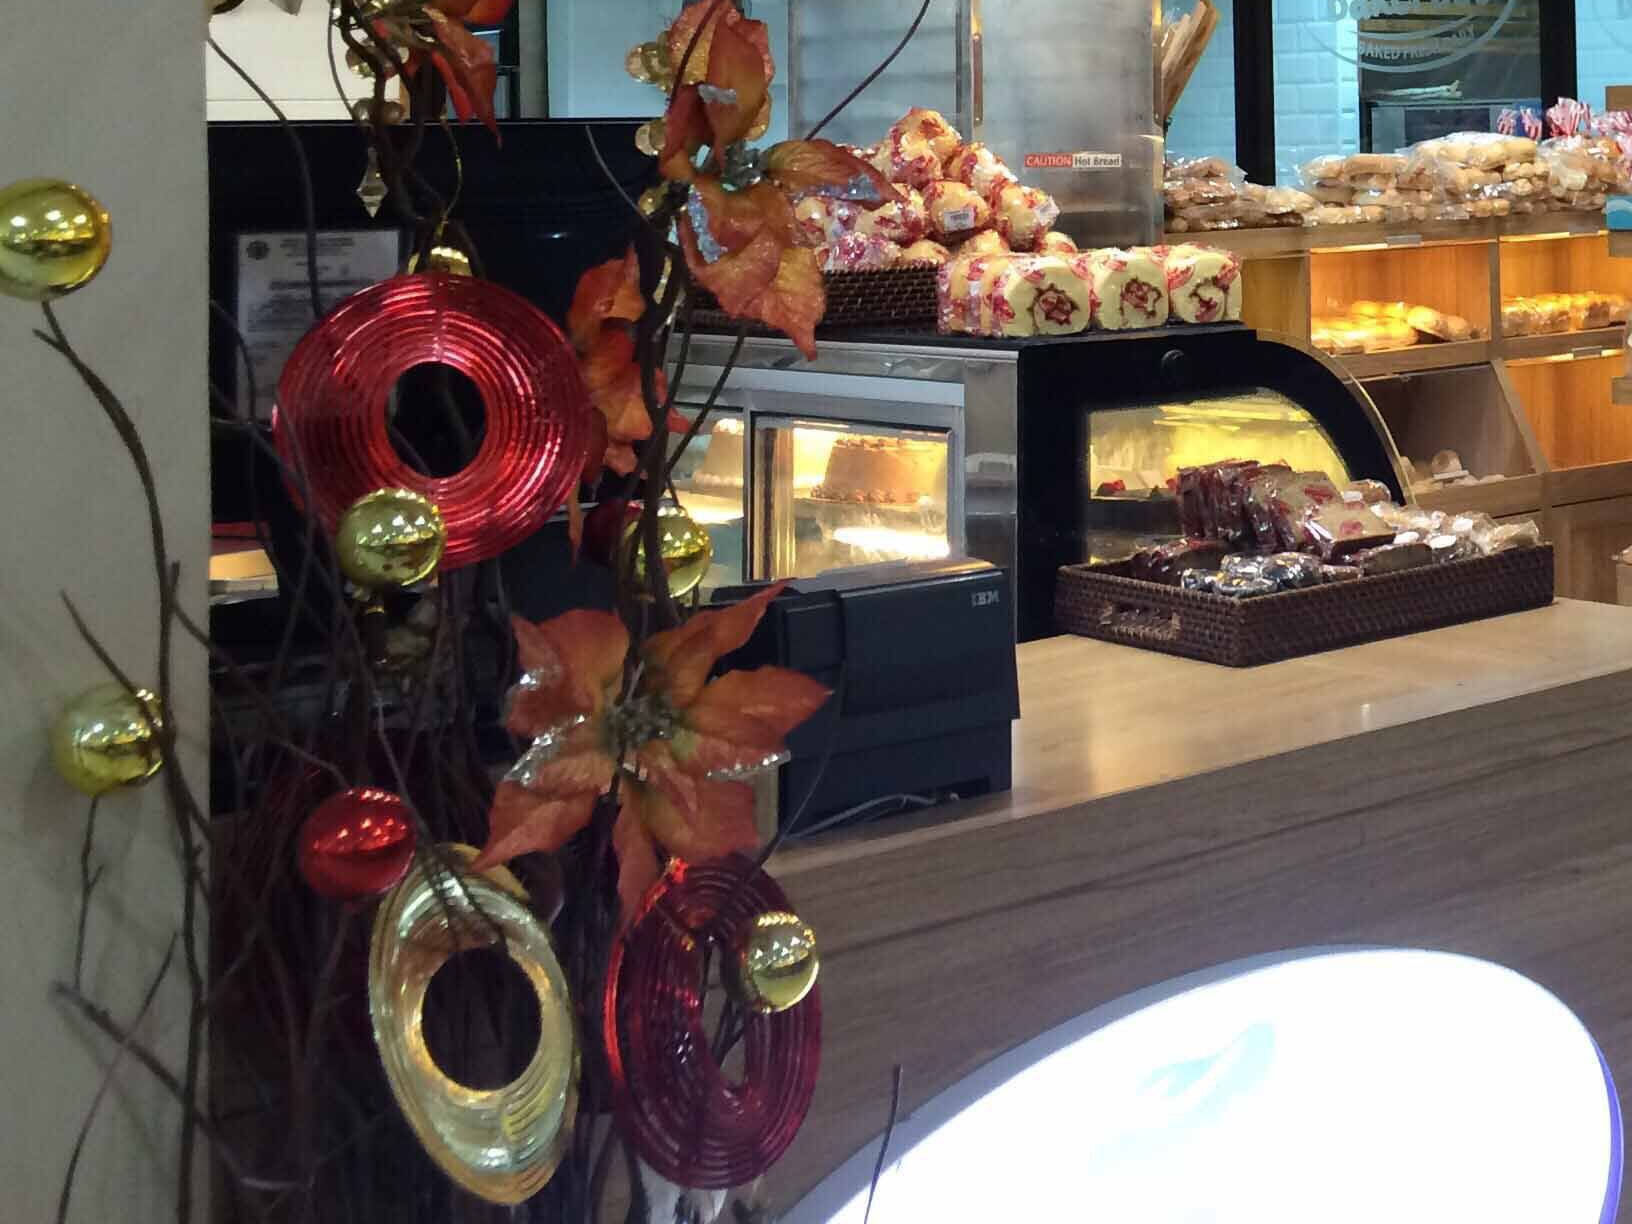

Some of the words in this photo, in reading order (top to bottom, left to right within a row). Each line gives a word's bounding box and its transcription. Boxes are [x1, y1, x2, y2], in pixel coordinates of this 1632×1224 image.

[1026, 156, 1072, 167] CAUTION
[1075, 156, 1092, 166] Hot
[1094, 156, 1120, 166] Bread
[971, 590, 1000, 607] IBM
